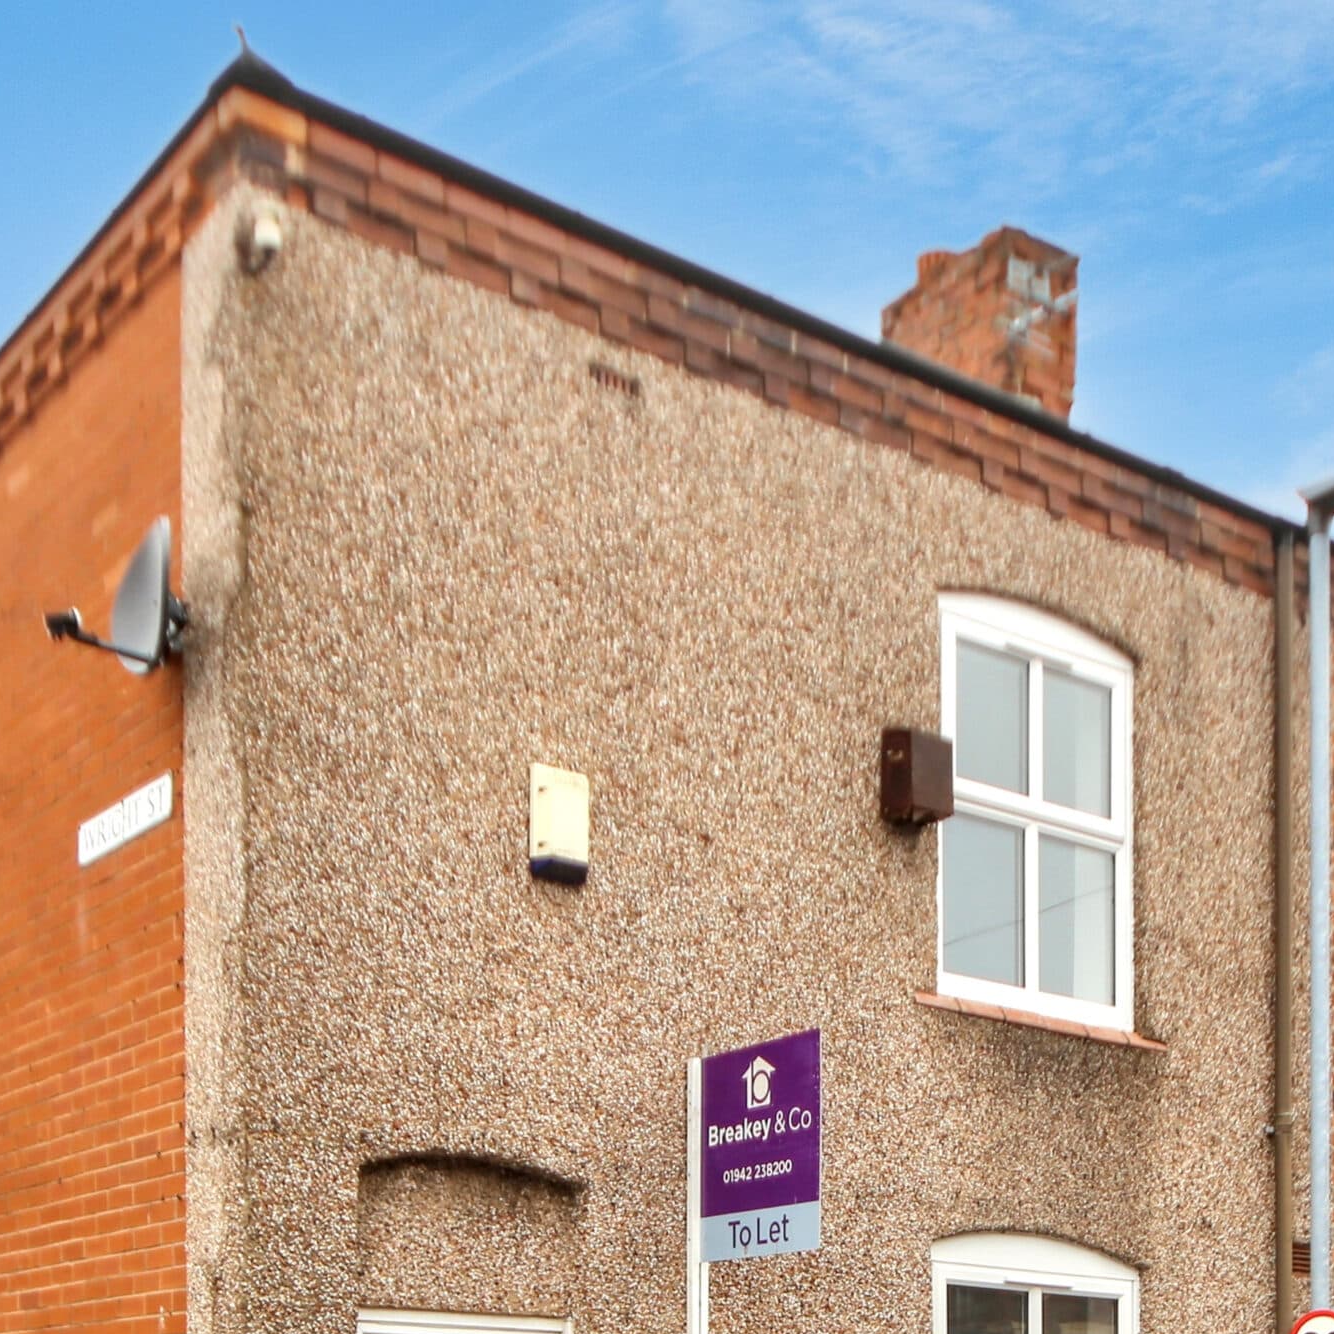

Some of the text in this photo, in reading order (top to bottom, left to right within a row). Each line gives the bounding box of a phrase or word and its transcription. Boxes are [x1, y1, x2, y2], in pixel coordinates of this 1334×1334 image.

[708, 1106, 812, 1147] Breakey & Co
[723, 1159, 792, 1184] 01942 238200
[728, 1213, 789, 1248] To Let
